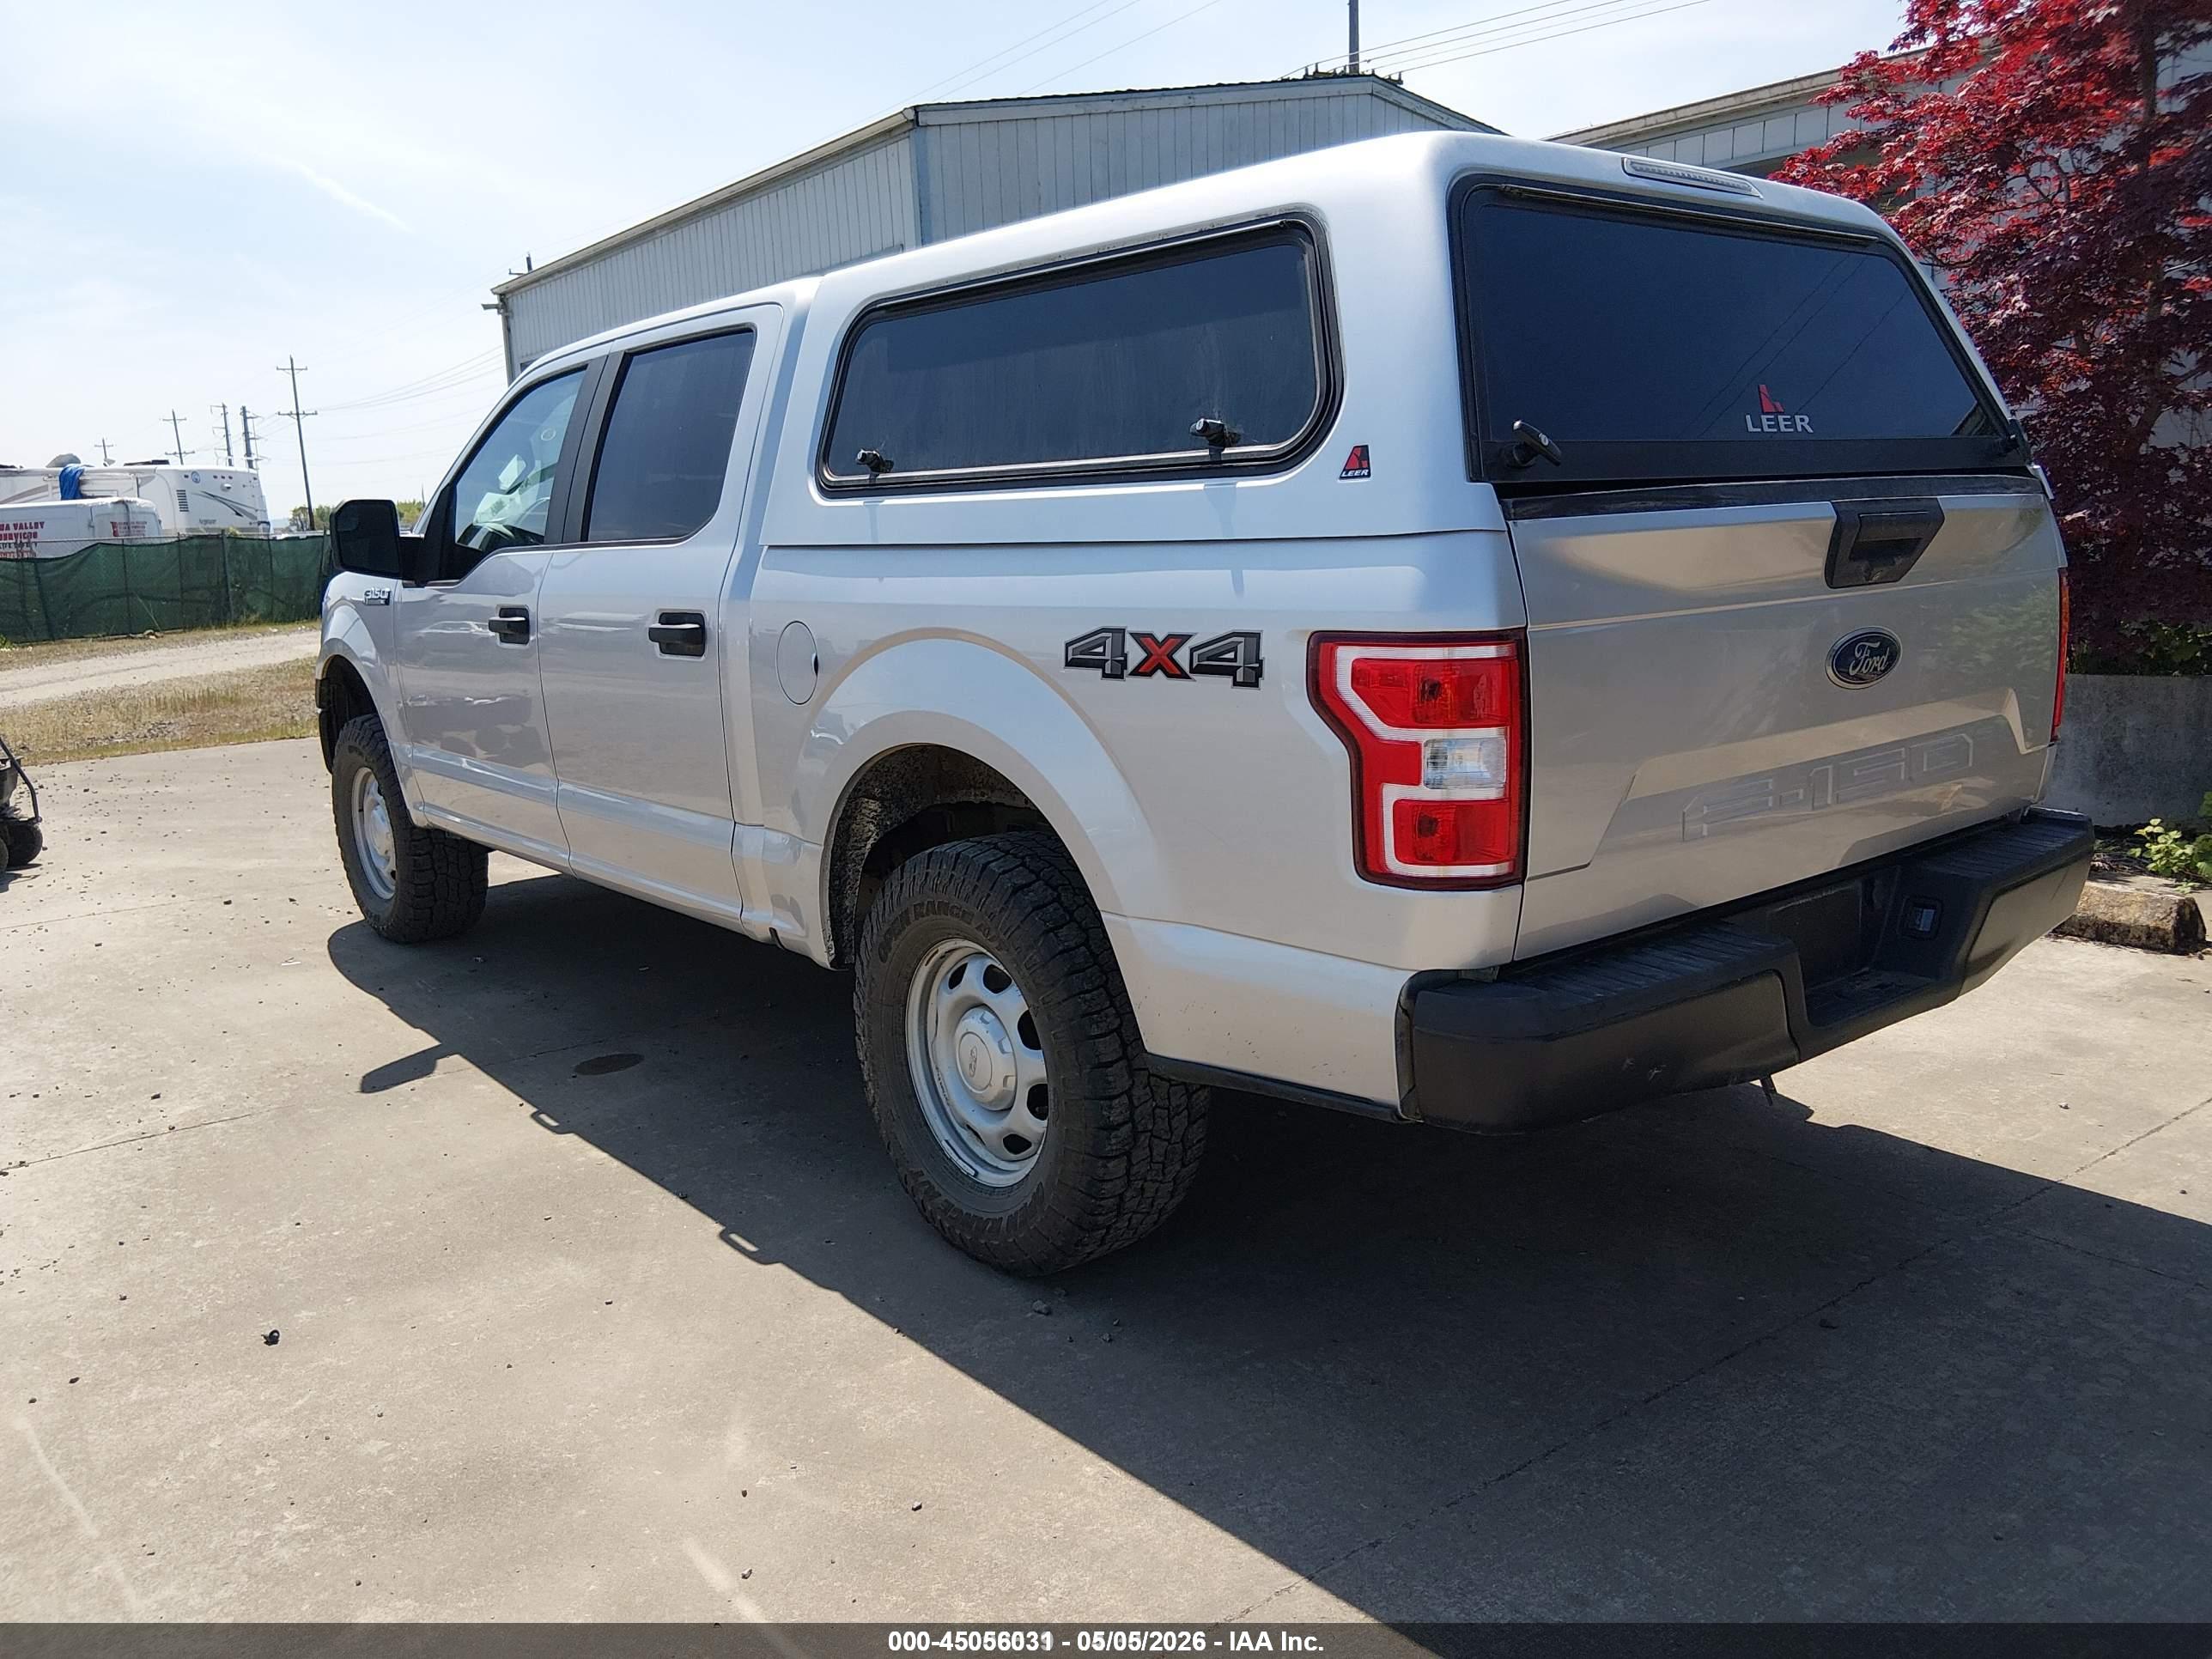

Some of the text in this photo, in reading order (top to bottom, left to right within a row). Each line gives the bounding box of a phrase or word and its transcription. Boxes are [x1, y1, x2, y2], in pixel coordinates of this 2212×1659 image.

[1745, 414, 1814, 434] LEER
[1340, 469, 1369, 477] LEER
[13, 521, 45, 531] VALLEY
[1848, 641, 1890, 677] Ford
